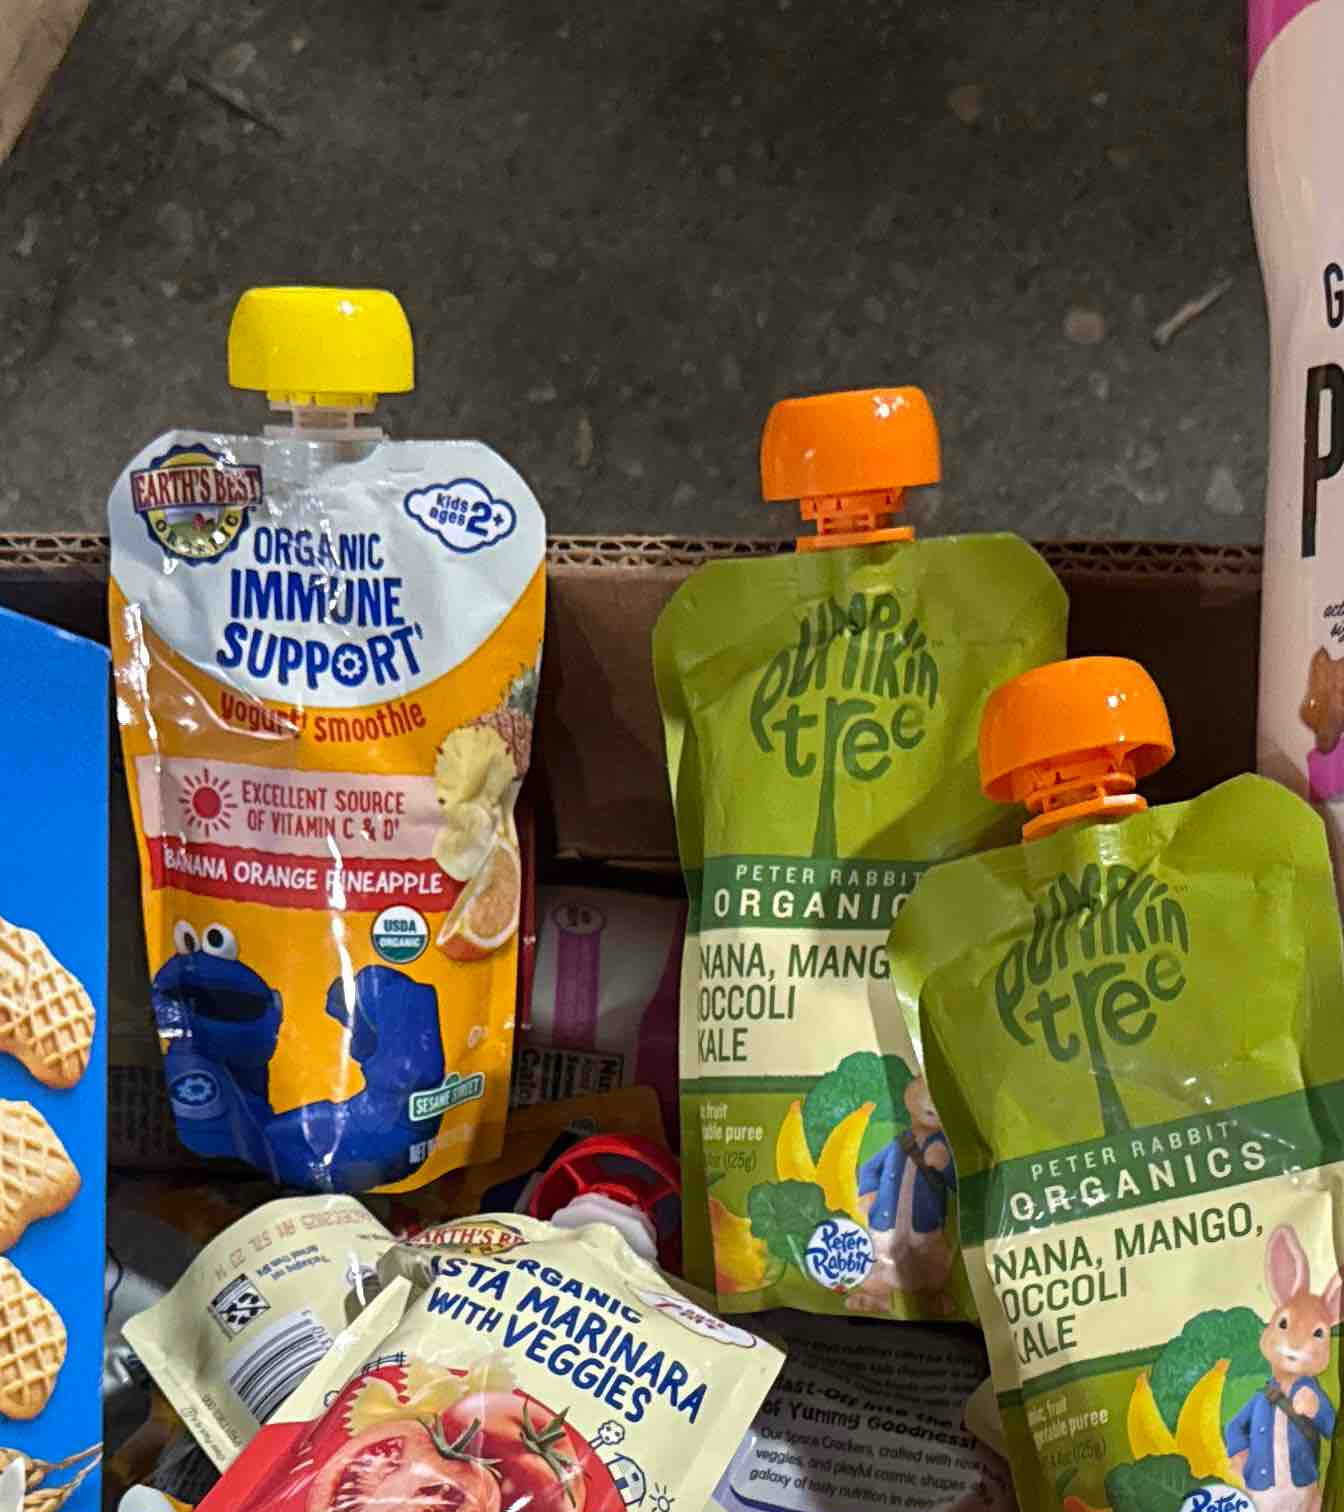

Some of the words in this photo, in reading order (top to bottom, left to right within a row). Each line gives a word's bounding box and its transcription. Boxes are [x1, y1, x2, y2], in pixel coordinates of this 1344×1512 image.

[133, 467, 210, 511] EARTH'S
[214, 467, 257, 507] BEST
[253, 527, 384, 571] ORGANIC
[230, 569, 403, 627] IMMUNE
[314, 703, 426, 742] smoothie
[773, 697, 924, 781] tree
[241, 781, 326, 811] EXCELLENT
[336, 789, 404, 814] SOURCE
[271, 812, 335, 838] VITAMIN
[163, 847, 227, 881] BANANA
[234, 861, 316, 889] ORANGE
[383, 920, 416, 933] USDA
[1025, 950, 1187, 1062] tree
[1009, 1141, 1265, 1222] ORGANICS
[1031, 1148, 1117, 1182] PETER
[822, 1221, 867, 1249] Peter
[1114, 1203, 1264, 1261] MANGO,
[805, 1245, 874, 1278] Rabbit
[427, 1286, 505, 1333] WITH
[502, 1314, 655, 1424] VEGGIES
[516, 1287, 707, 1424] MARINARA
